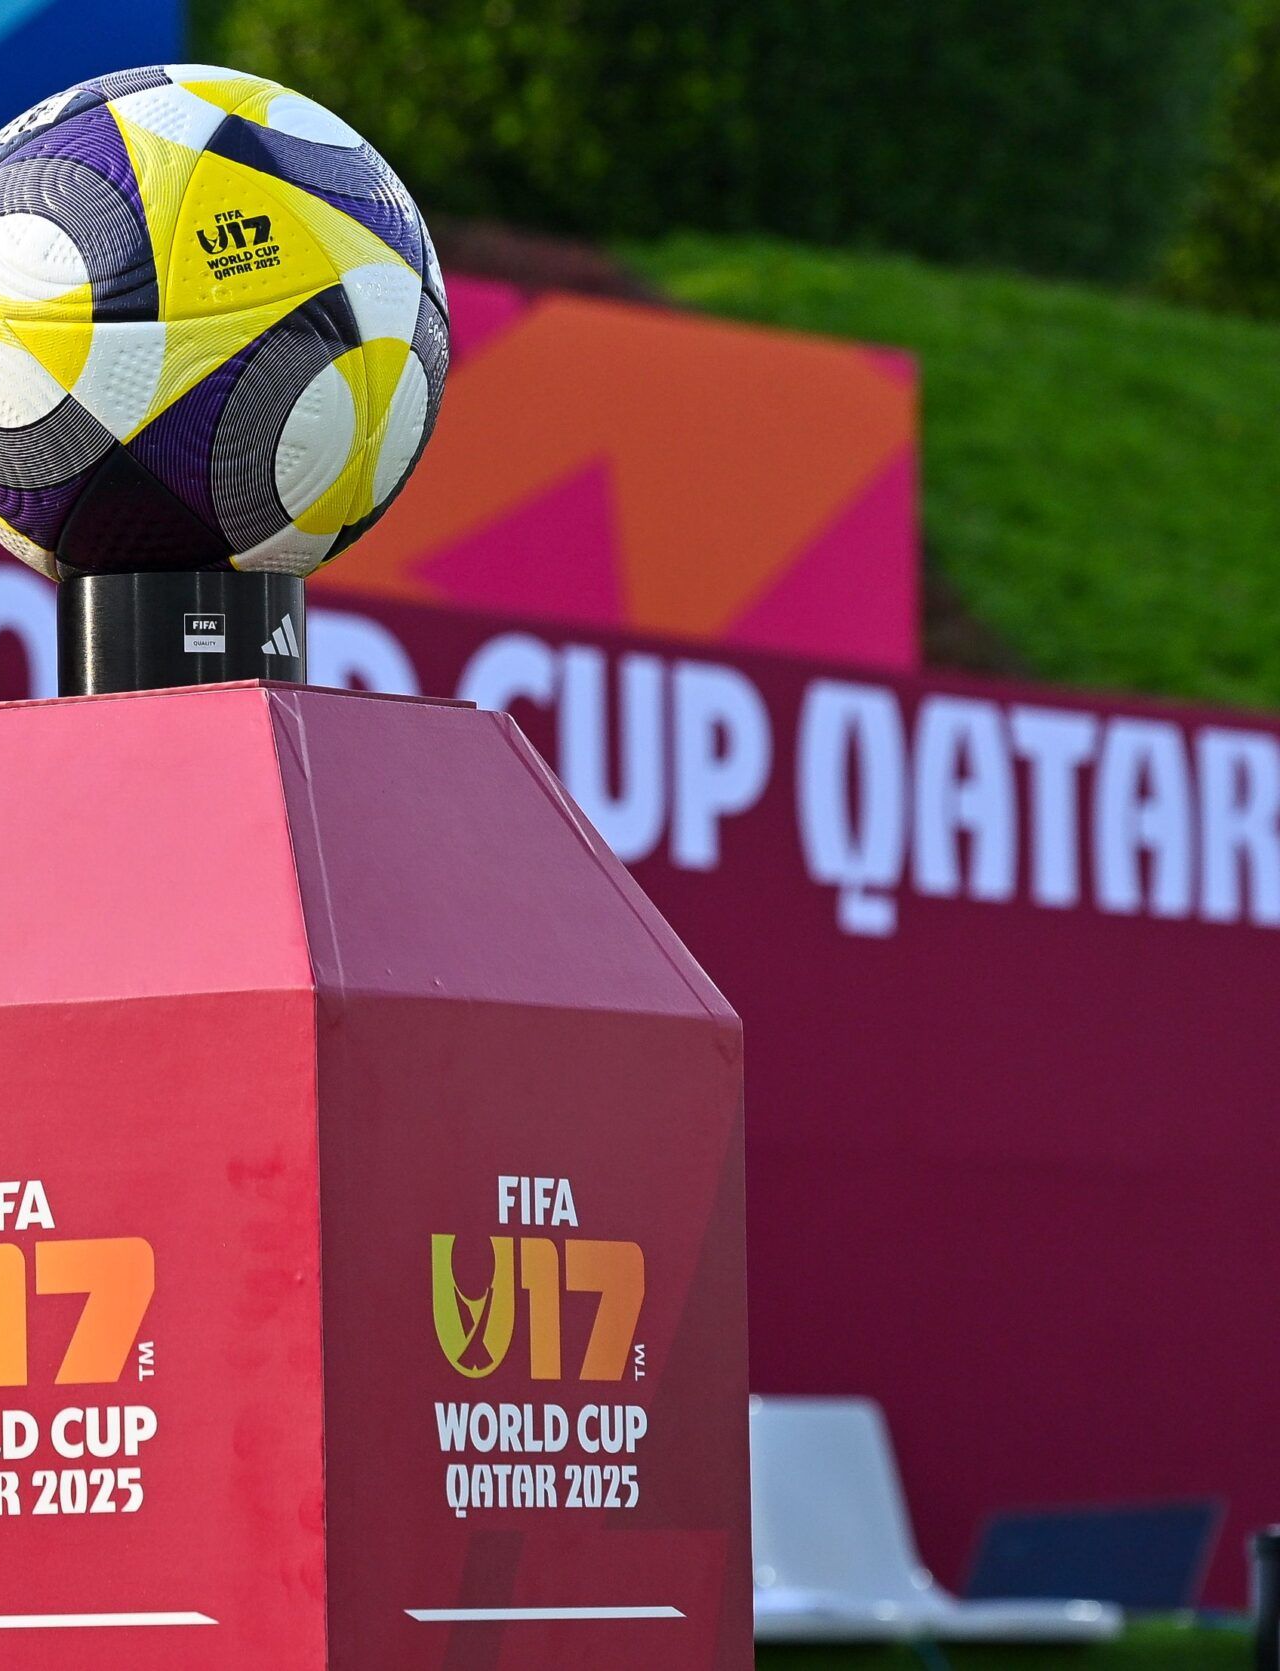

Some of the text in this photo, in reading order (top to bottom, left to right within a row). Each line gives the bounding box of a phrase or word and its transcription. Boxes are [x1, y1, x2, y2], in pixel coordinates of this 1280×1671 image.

[196, 215, 271, 254] U17
[214, 209, 244, 223] FIFA
[207, 245, 280, 270] WORLD CUP
[214, 256, 281, 280] QATAR 2025
[192, 620, 216, 630] FIFA
[798, 679, 1280, 937] QATAR
[498, 1175, 579, 1227] FIFA
[431, 1233, 645, 1379] U17
[50, 1405, 158, 1459] CUP
[434, 1402, 648, 1454] WORLD CUP
[31, 1467, 144, 1515] 2025
[446, 1464, 639, 1518] QATAR 2025
